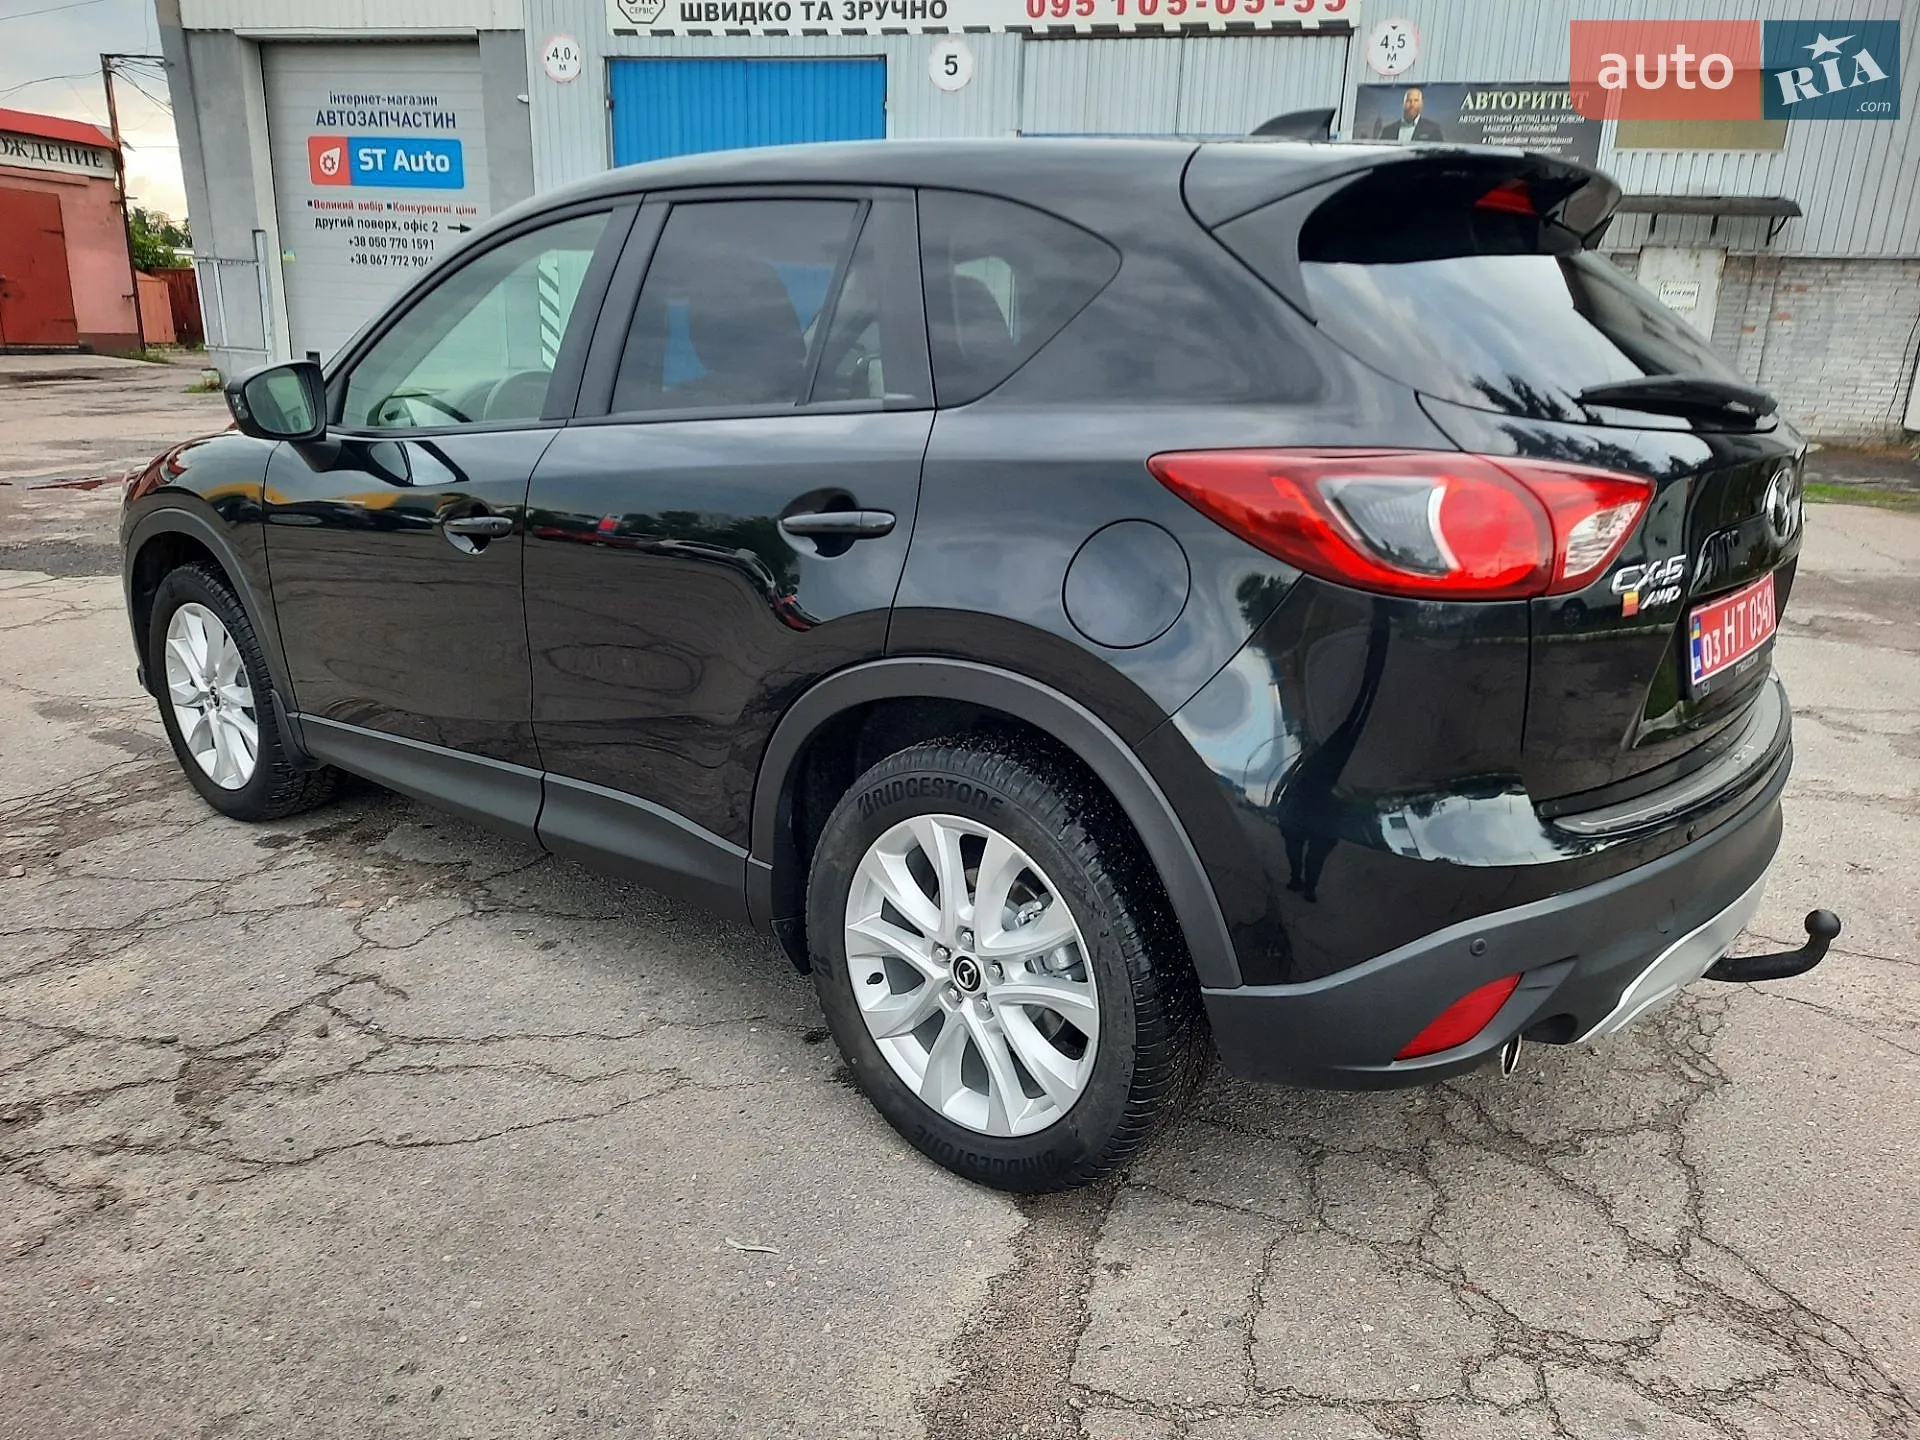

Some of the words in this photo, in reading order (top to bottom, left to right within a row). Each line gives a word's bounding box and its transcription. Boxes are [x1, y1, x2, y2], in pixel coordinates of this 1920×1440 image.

[629, 6, 655, 15] СЕРВІС
[680, 1, 792, 26] ШВИДКО
[800, 0, 834, 21] ТА
[842, 0, 949, 21] ЗРУЧНО
[1026, 0, 1096, 18] 095
[1380, 33, 1406, 51] 4,5
[551, 47, 571, 61] 4,0
[944, 54, 958, 76] 5
[329, 91, 438, 107] інтернет-магазин
[316, 110, 457, 129] АВТОЗАПЧАСТИН
[358, 147, 387, 171] ST
[393, 149, 450, 173] Auto
[313, 200, 354, 211] Великий
[358, 200, 384, 213] вибір
[393, 201, 452, 215] Конкурентні
[456, 205, 477, 216] ціни
[315, 215, 354, 231] другий
[403, 218, 428, 235] офіс
[432, 220, 439, 234] 2
[349, 235, 366, 248] +38
[368, 236, 387, 249] 050
[390, 237, 408, 249] 770
[412, 238, 434, 251] 1591
[351, 253, 367, 265] +38
[370, 254, 388, 266] 067
[391, 254, 409, 267] 772
[1703, 628, 1721, 670] 03
[857, 777, 1004, 821] BRIDGESTONE
